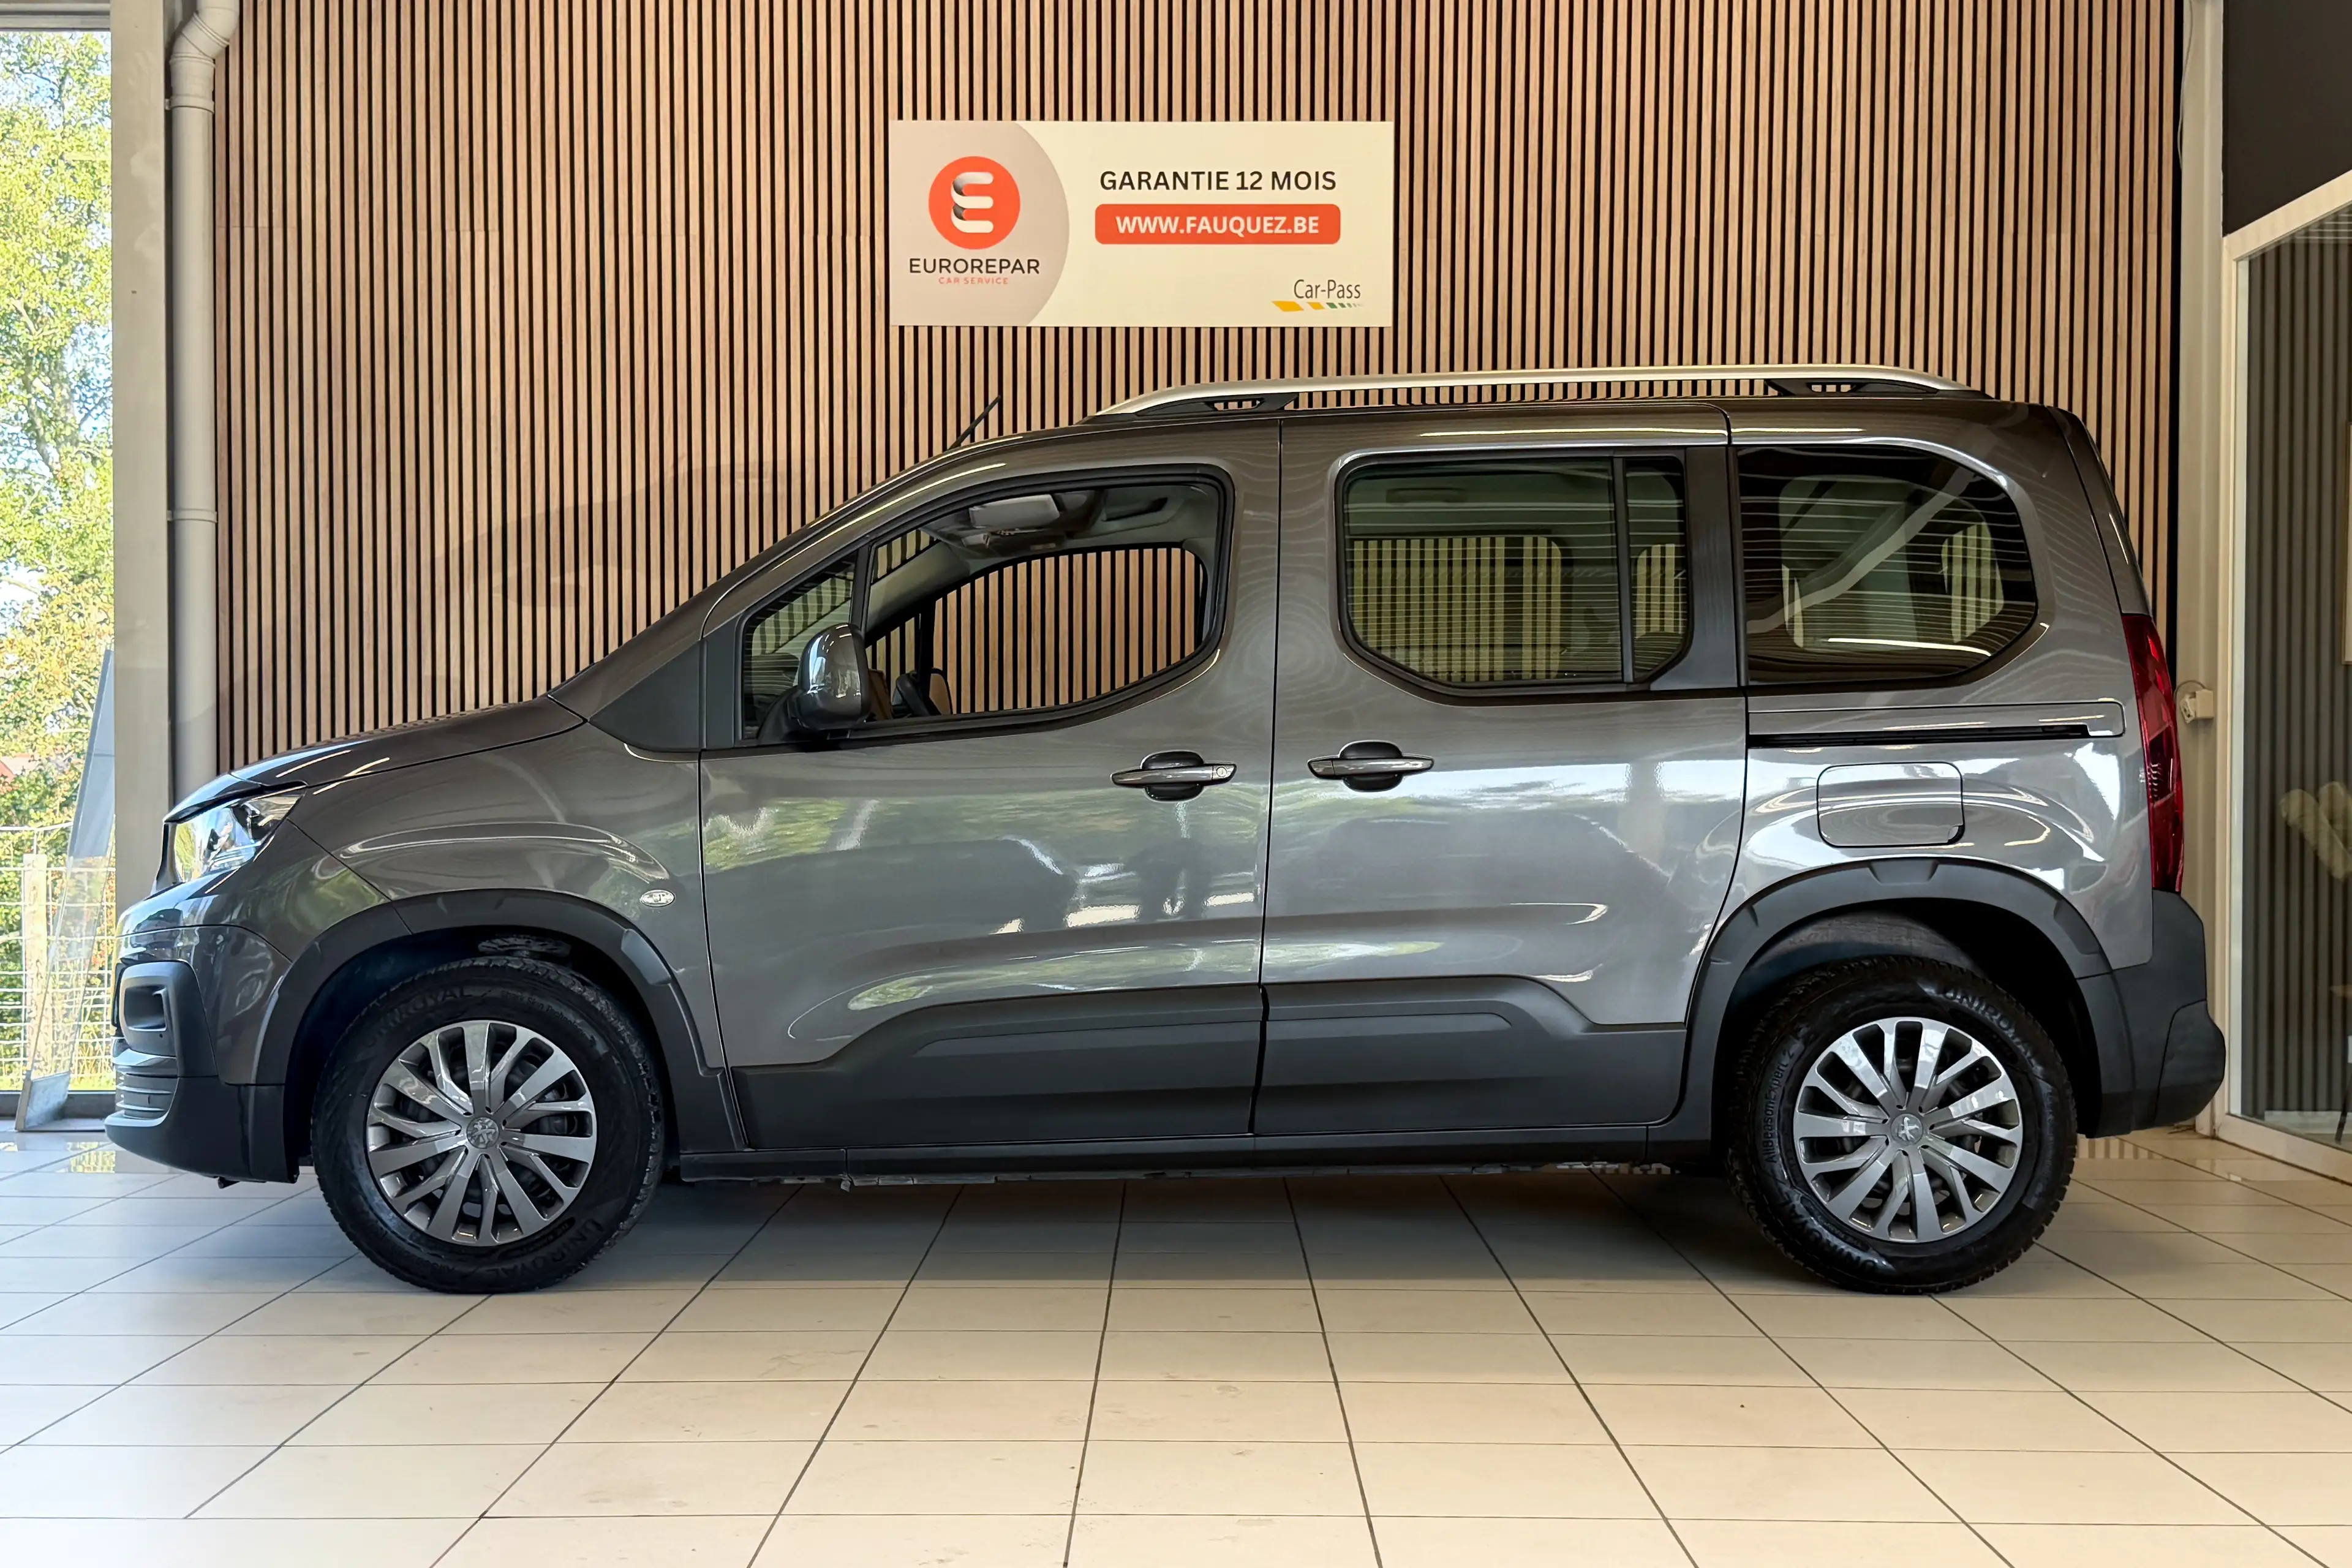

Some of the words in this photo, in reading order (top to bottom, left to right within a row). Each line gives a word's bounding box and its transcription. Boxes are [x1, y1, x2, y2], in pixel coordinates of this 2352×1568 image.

[1100, 171, 1230, 190] GARANTIE
[1236, 171, 1262, 190] 12
[1272, 171, 1336, 190] MOIS
[1115, 216, 1319, 237] WWW.FAUQUEZ.BE
[910, 258, 1039, 274] EUROREPAR
[1294, 279, 1361, 299] Car-Pass
